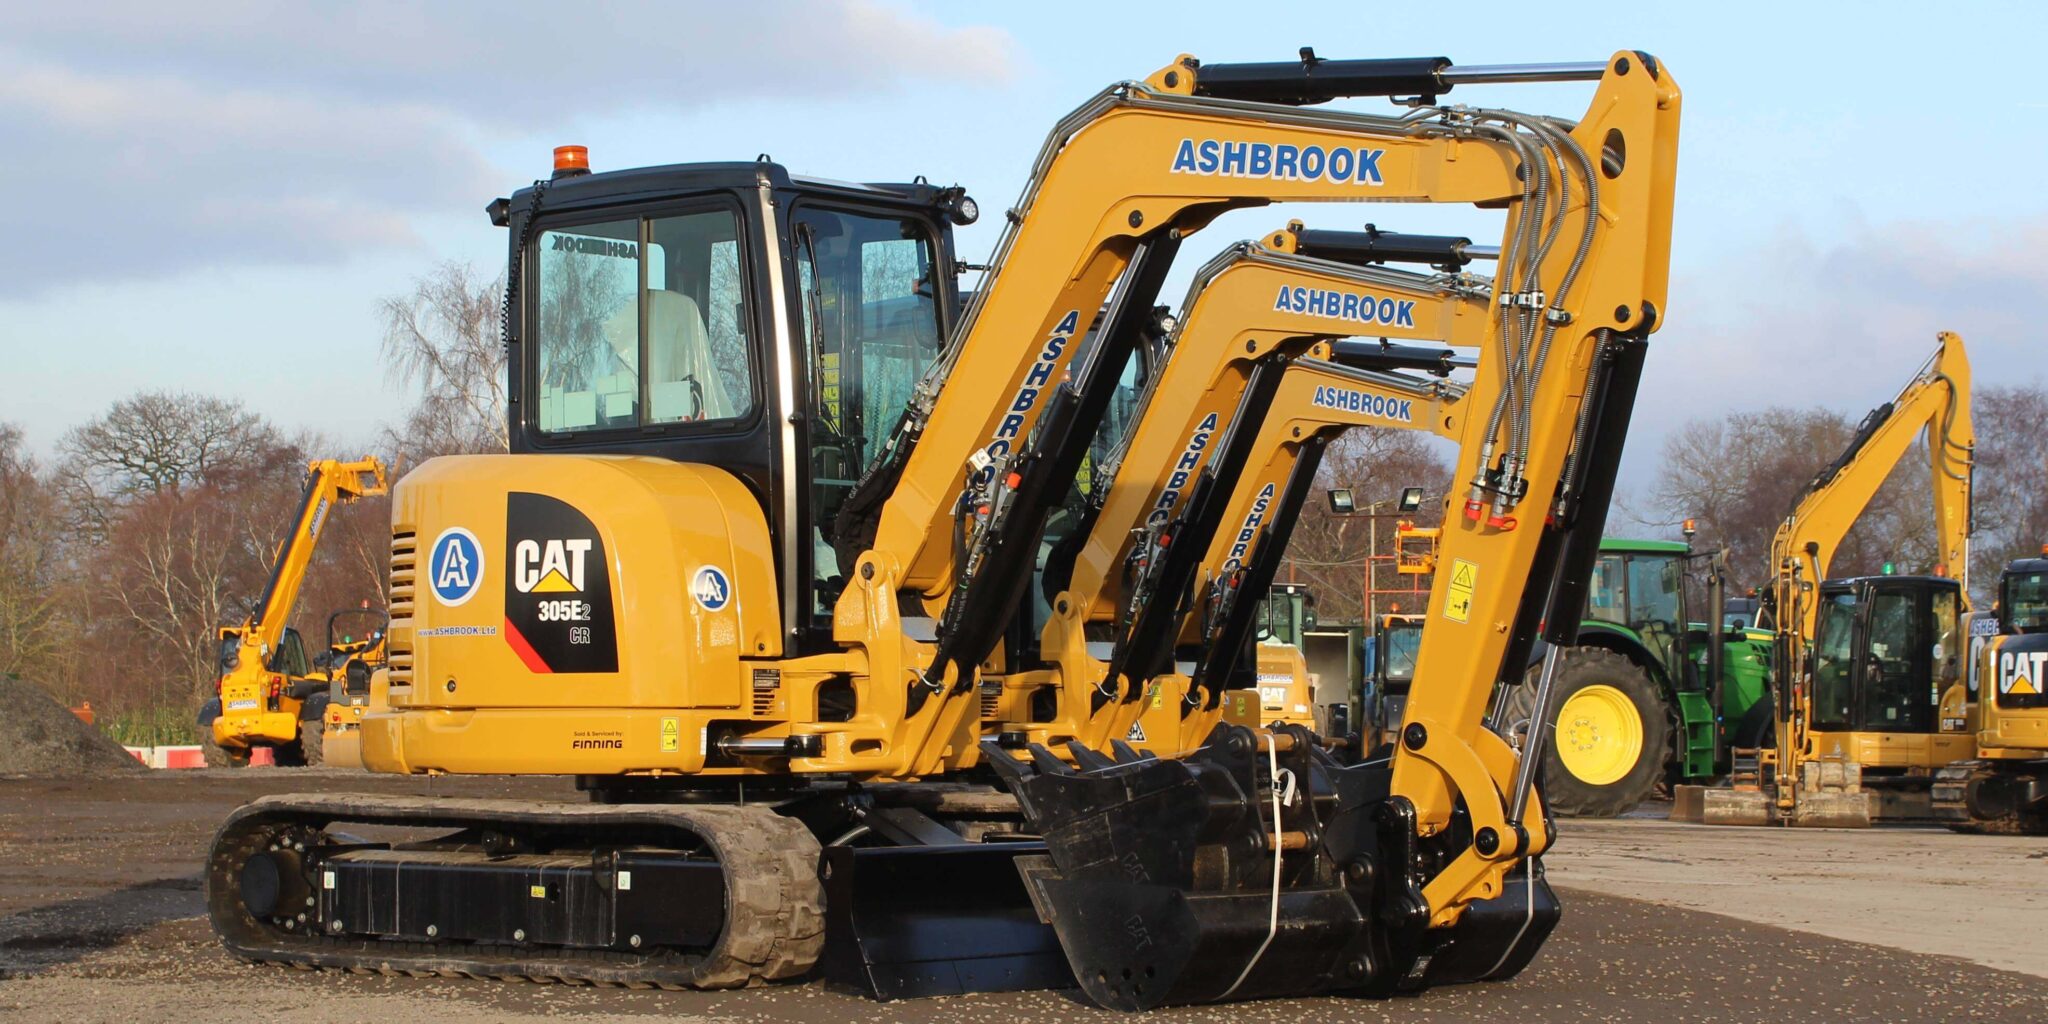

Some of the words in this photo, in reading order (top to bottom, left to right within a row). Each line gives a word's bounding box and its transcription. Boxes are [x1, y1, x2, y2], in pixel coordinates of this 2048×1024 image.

[1172, 138, 1385, 185] ASHBROOK
[1274, 285, 1415, 327] ASHBROOK
[962, 310, 1079, 512] ASHBROO
[1312, 385, 1412, 421] ASHBROOK
[1134, 412, 1218, 552] ASHBRO
[1215, 483, 1275, 587] ASHBRO
[515, 539, 591, 593] CAT
[538, 600, 591, 621] 305E2
[569, 627, 591, 644] CR
[2000, 652, 2047, 693] CAT
[1261, 687, 1286, 701] CAT
[573, 740, 622, 749] FINNING
